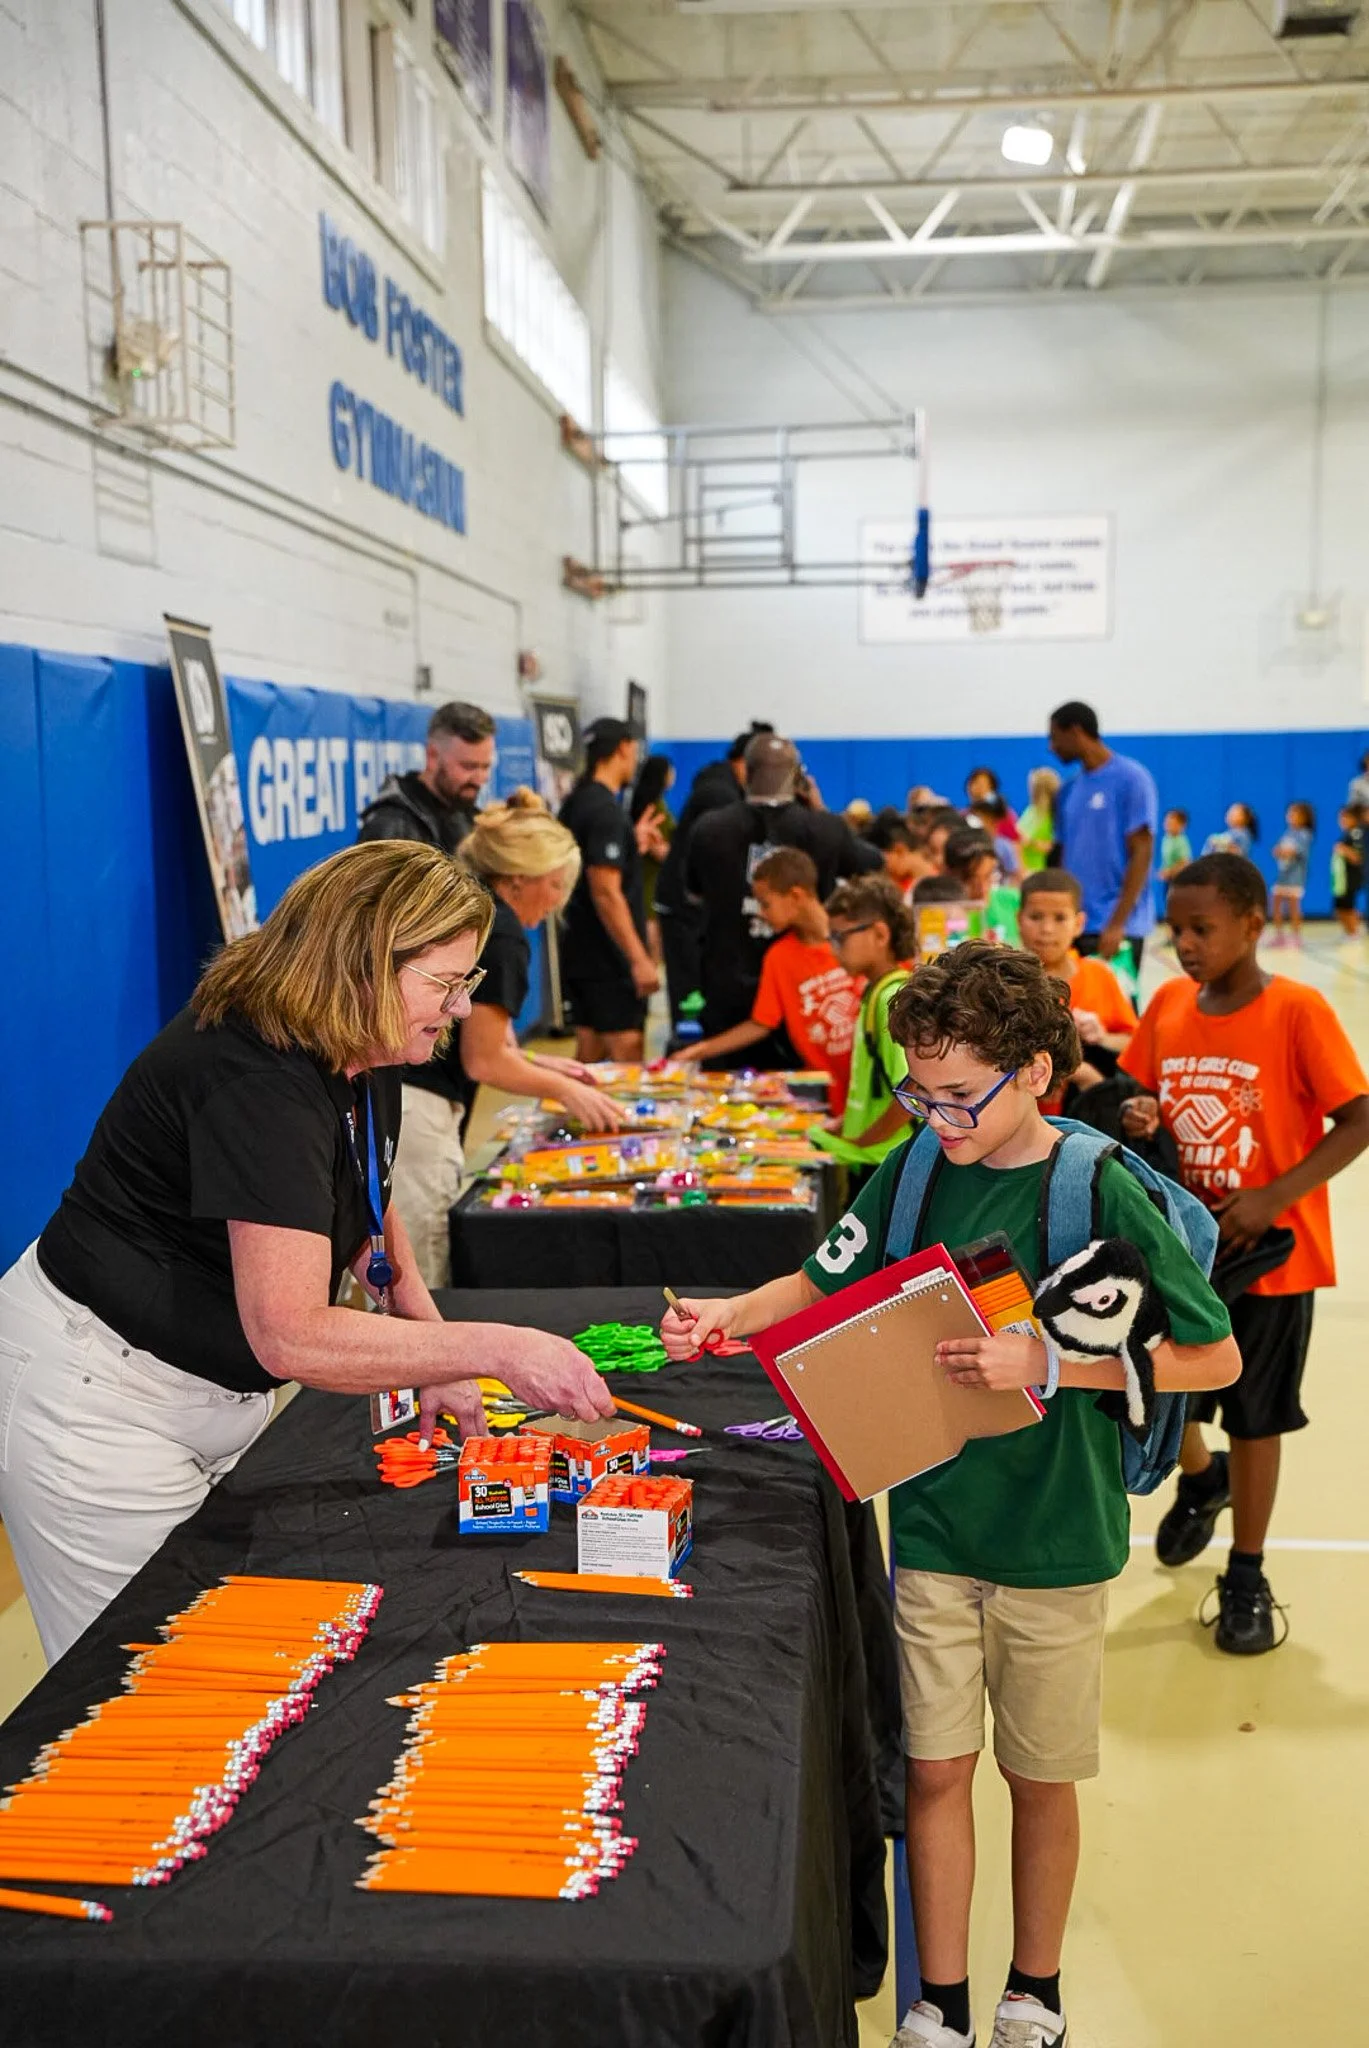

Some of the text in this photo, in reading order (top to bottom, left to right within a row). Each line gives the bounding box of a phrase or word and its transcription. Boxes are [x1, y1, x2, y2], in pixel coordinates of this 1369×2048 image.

[318, 208, 464, 419] BOB FOSTER
[329, 380, 466, 535] GYMNASIUM
[249, 736, 348, 846] GREAT
[1161, 1057, 1187, 1076] BOYS
[1197, 1056, 1230, 1074] GIRLS
[1227, 1060, 1260, 1081] CLUB
[815, 1212, 869, 1275] 3
[474, 1486, 488, 1498] 30
[474, 1503, 495, 1511] School
